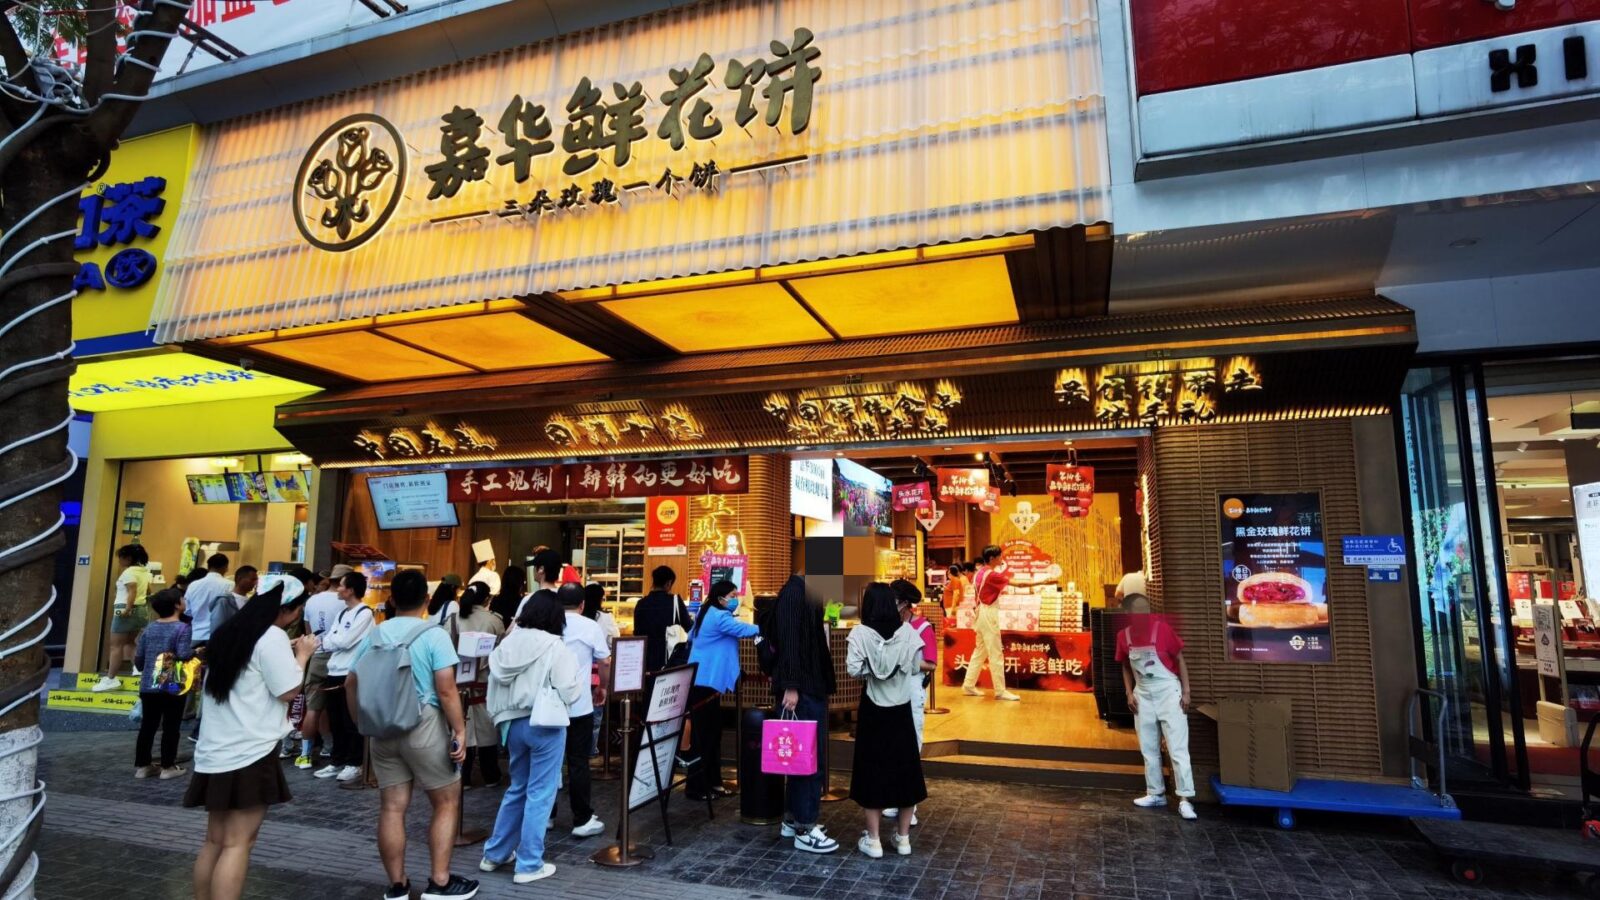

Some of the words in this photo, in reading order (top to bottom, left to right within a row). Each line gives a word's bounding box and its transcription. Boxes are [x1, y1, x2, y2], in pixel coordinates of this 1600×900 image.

[425, 27, 822, 201] 嘉华鲜花饼
[497, 158, 721, 219] 三朵玫瑰一个饼
[460, 467, 553, 495] 手工现制
[578, 459, 741, 492] 新鲜的更好吃
[1235, 526, 1312, 538] 黑金玫瑰鲜花饼
